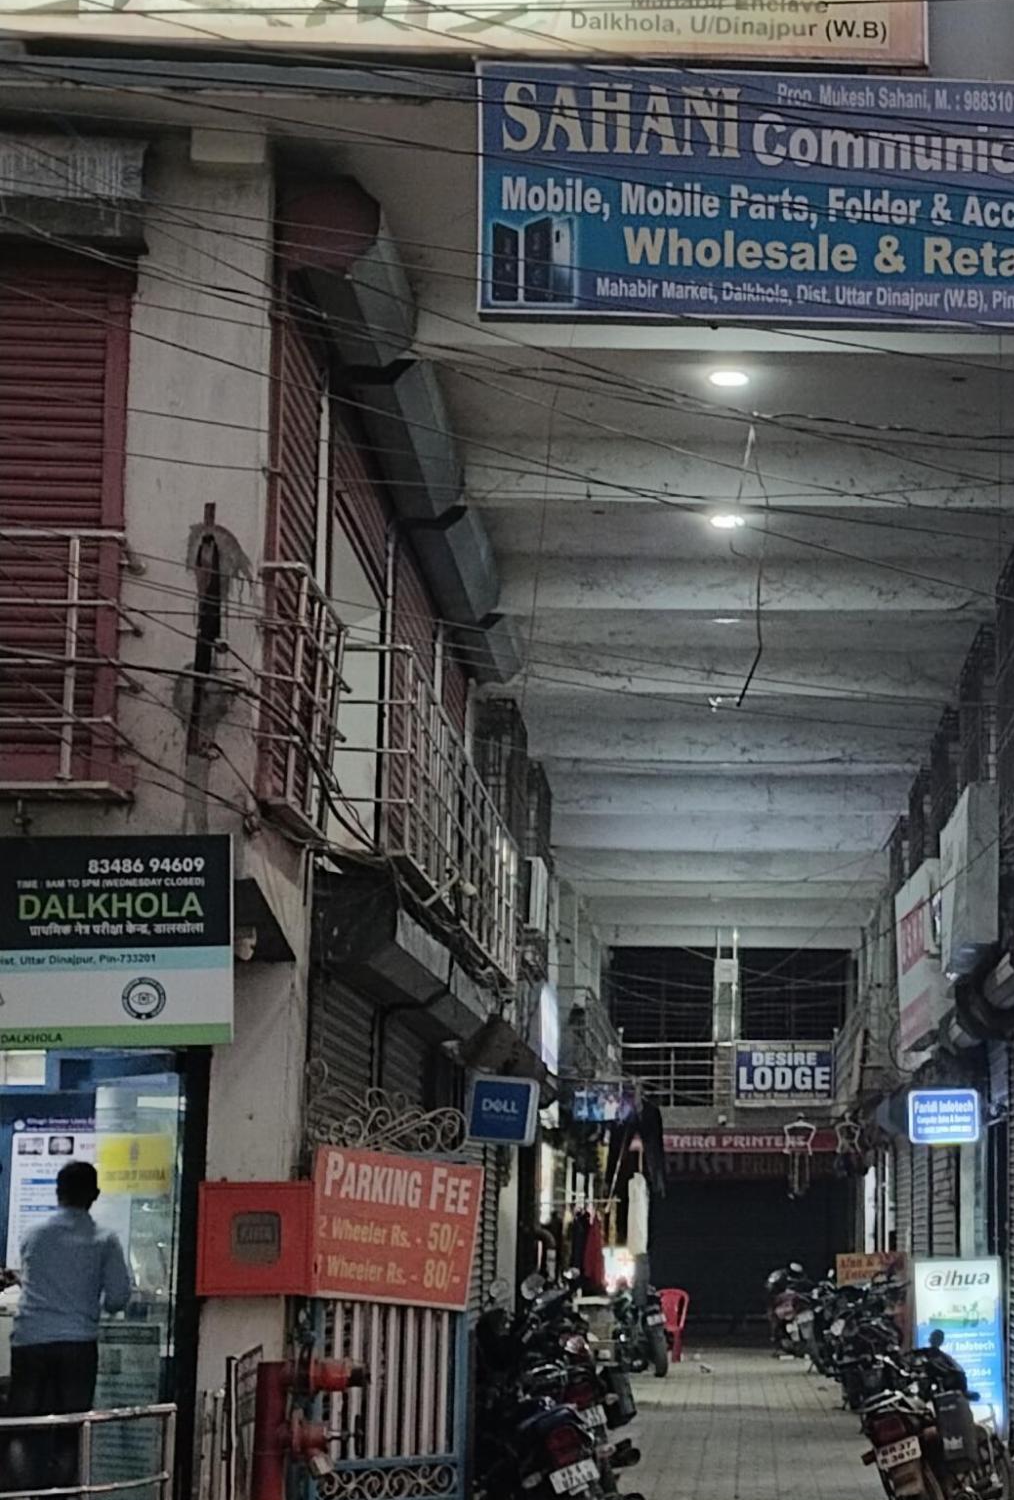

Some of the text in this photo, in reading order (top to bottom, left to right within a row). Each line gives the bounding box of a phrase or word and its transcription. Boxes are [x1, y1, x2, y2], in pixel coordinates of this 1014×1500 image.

[571, 11, 888, 44] Dalkhola, U/Dinajpur (W.B)
[820, 84, 875, 107] Mukesh
[878, 86, 931, 111] Sahani,
[502, 81, 742, 159] SAHANI
[501, 176, 611, 221] Mobile,
[620, 181, 720, 219] Mobile
[729, 184, 818, 229] Parts,
[828, 187, 921, 225] Folder
[930, 193, 953, 227] &
[622, 226, 859, 273] Wholesale
[873, 234, 907, 275] &
[596, 277, 657, 299] Mahabir
[661, 279, 719, 304] Market,
[722, 282, 792, 306] Dalkhola,
[796, 285, 830, 305] Dist.
[835, 285, 873, 306] Uttar
[876, 287, 941, 311] Dinajpur
[88, 857, 205, 874] 83486 94609
[67, 878, 80, 888] TO
[18, 891, 204, 920] DALKHOLA
[93, 921, 124, 935] परीक्षा
[20, 955, 45, 965] Uttar
[752, 1052, 817, 1066] DESIRE
[739, 1066, 831, 1091] LODGE
[482, 1097, 519, 1114] DELL
[939, 1099, 974, 1113] Infotech
[663, 1134, 808, 1148] TARA PRINTERS
[332, 1216, 387, 1245] Wheeler
[390, 1224, 411, 1248] Rs.
[427, 1222, 465, 1255] 50/-
[327, 1255, 383, 1281] Wheeler
[386, 1262, 406, 1284] Rs.
[423, 1259, 460, 1292] 80/-
